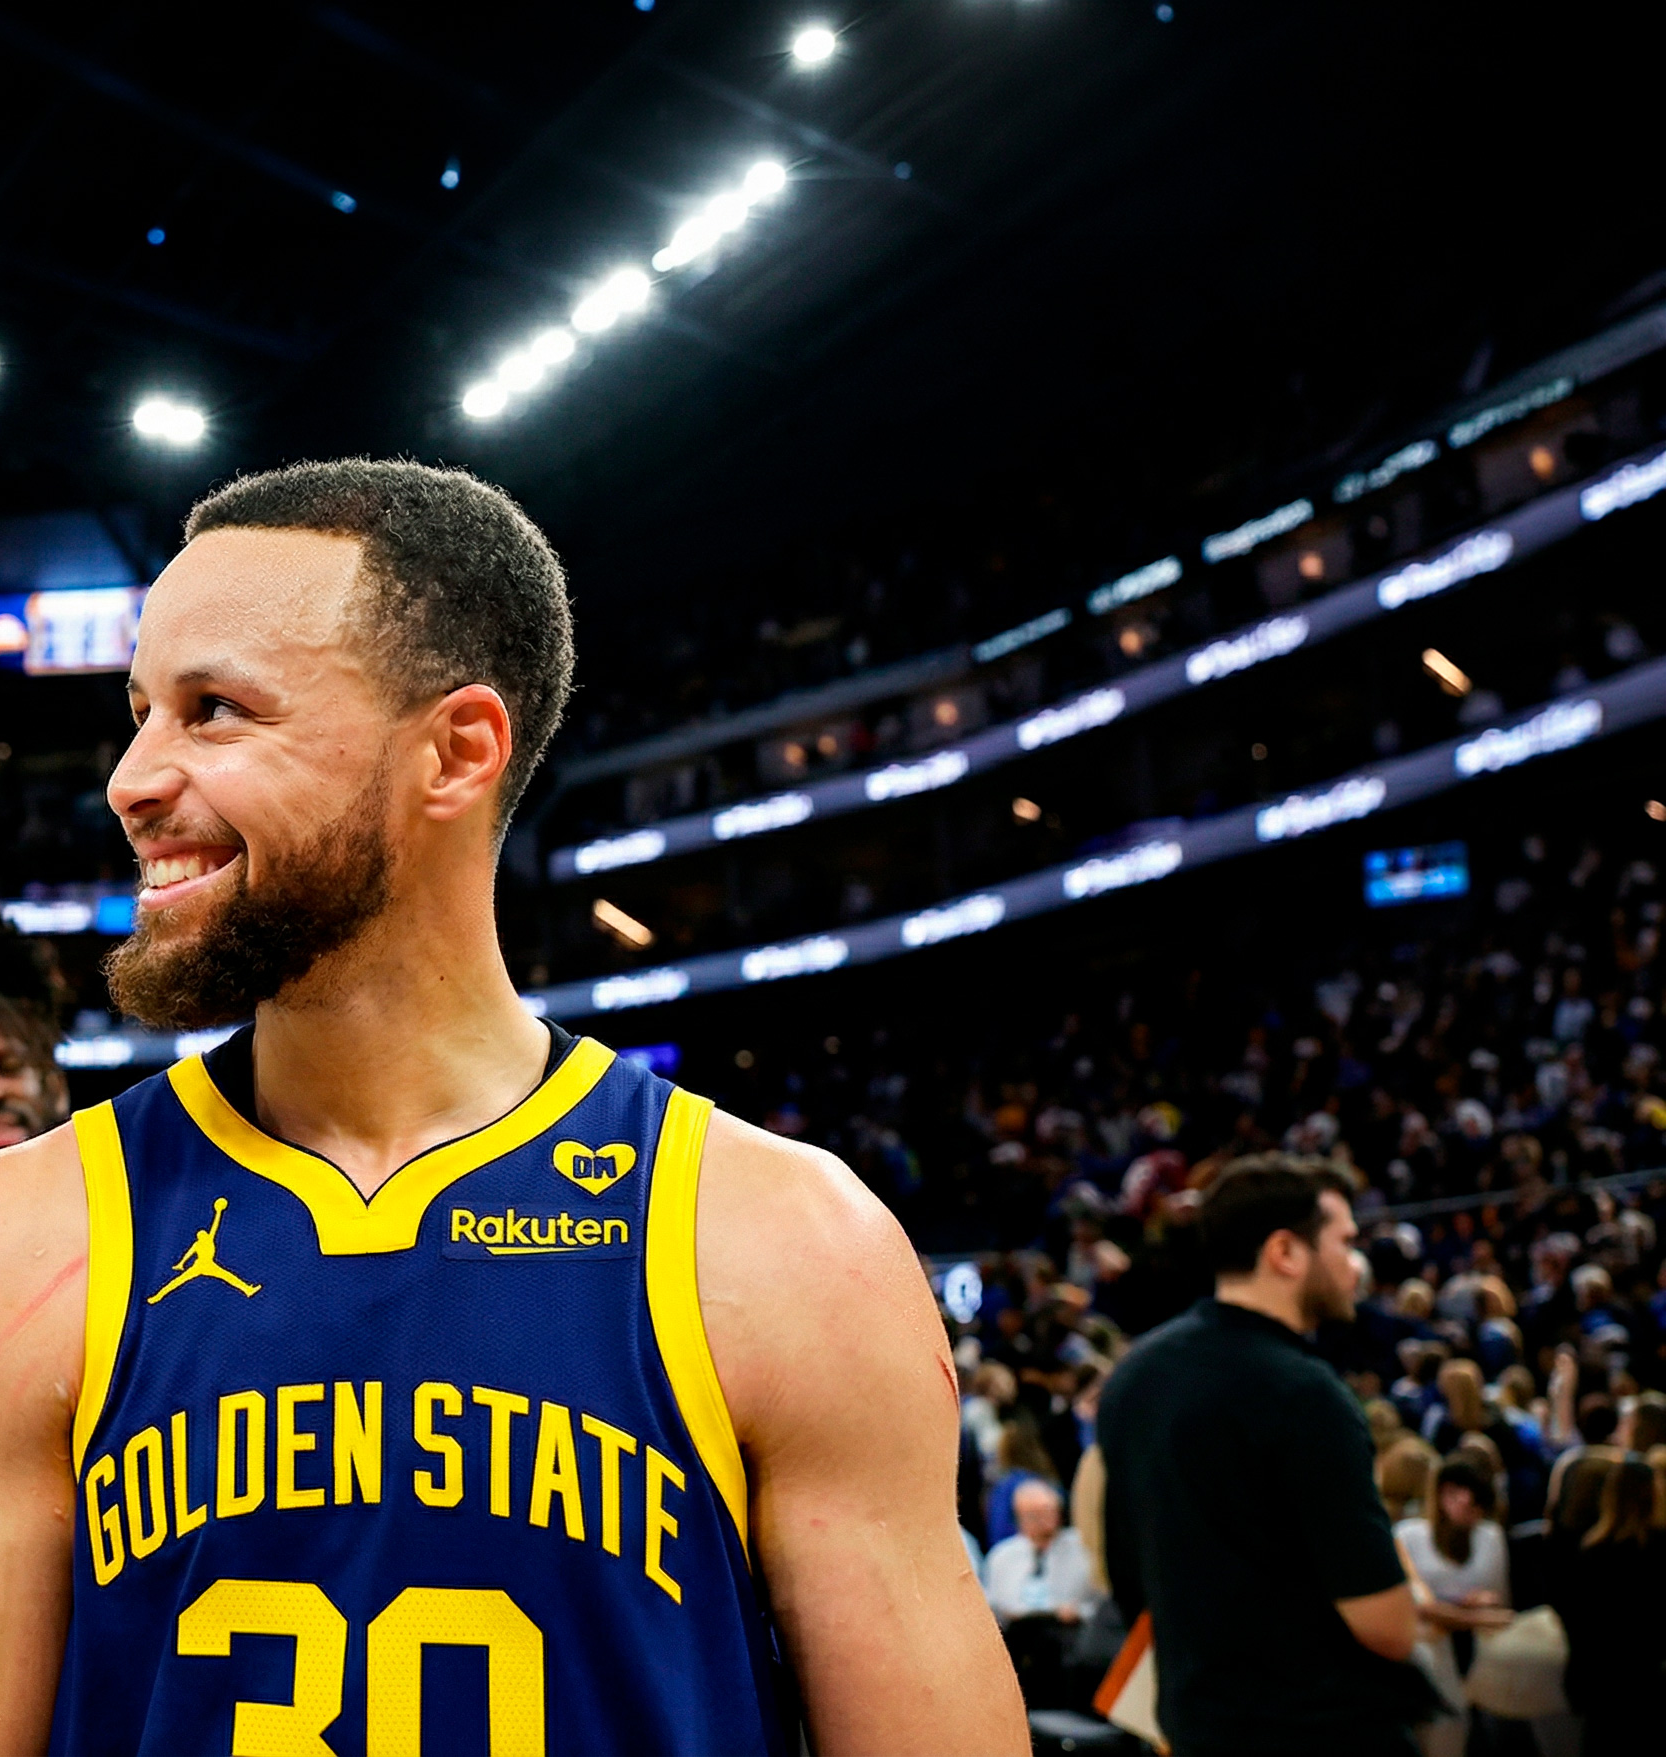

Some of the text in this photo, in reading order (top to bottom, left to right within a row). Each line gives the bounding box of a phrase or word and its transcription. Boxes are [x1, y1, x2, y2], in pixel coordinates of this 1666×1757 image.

[450, 1207, 629, 1246] Rakuten
[85, 1381, 686, 1606] GOLDEN STATE
[176, 1578, 546, 1757] 30
